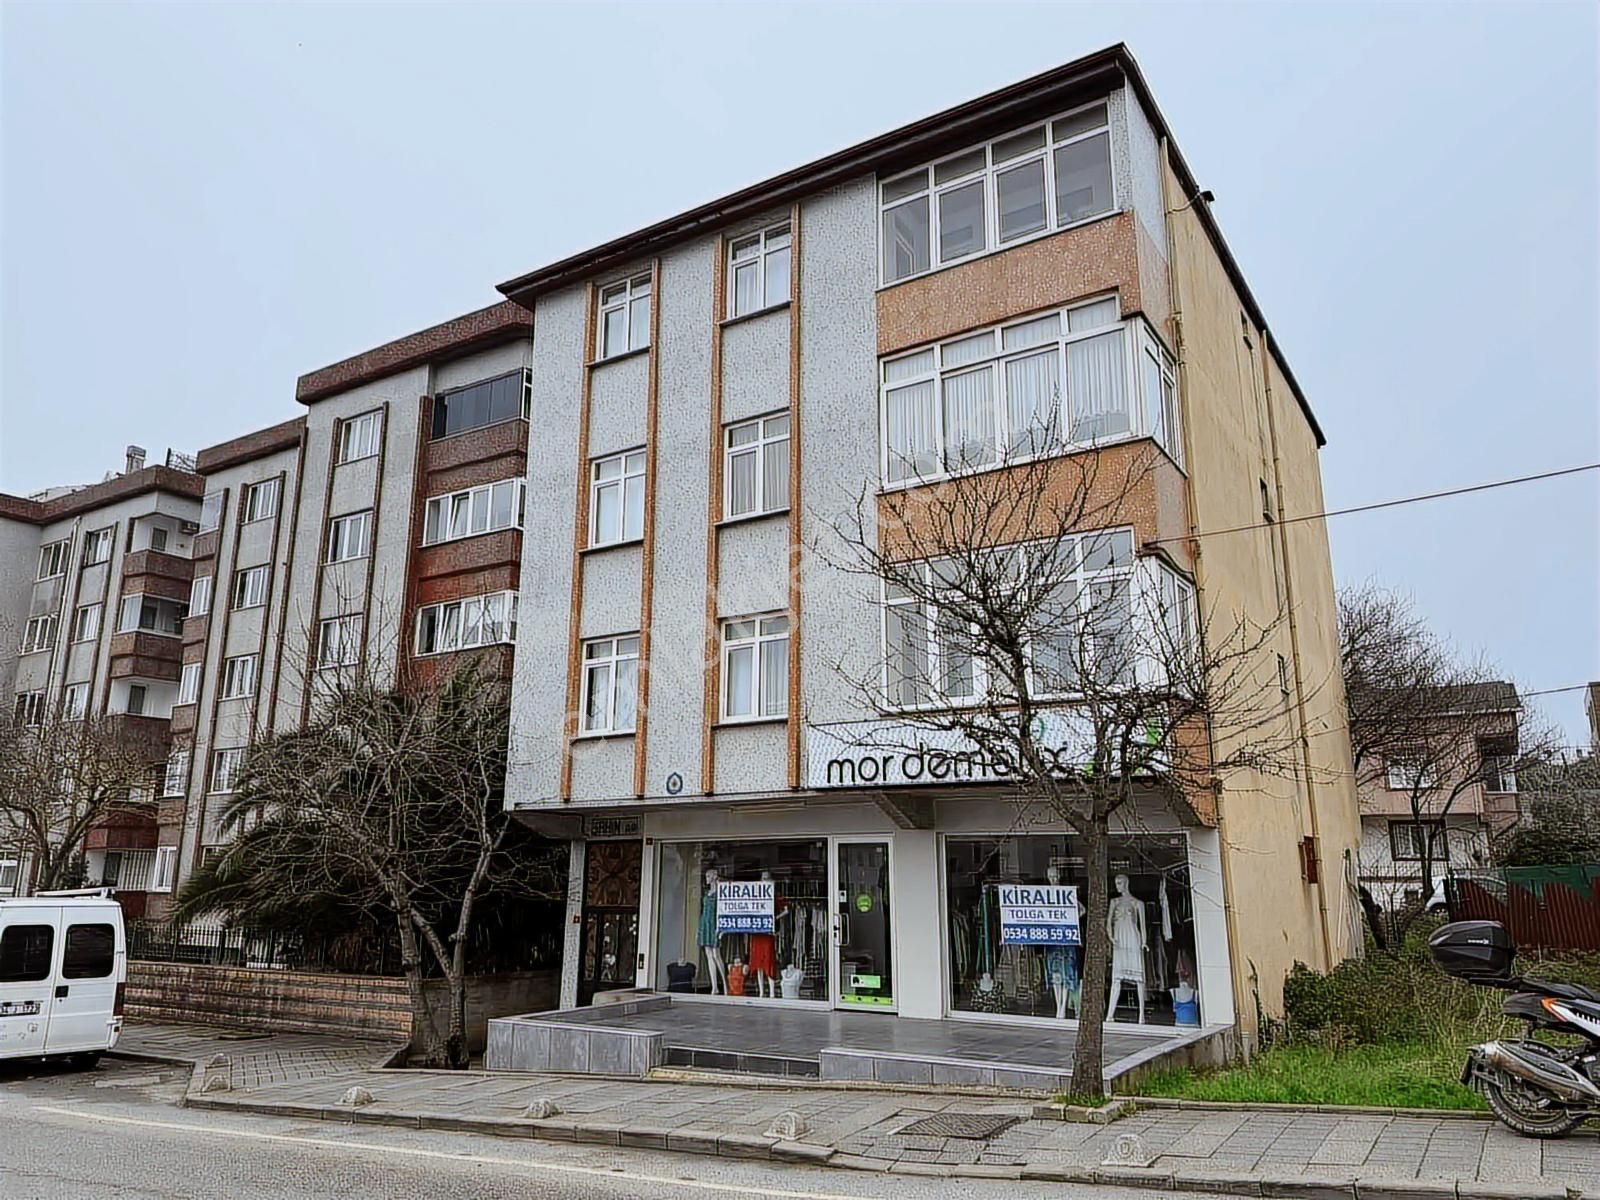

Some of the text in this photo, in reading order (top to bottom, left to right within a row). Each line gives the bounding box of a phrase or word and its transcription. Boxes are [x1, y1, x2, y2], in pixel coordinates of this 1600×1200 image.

[1002, 886, 1074, 905] KİRALIK
[1010, 909, 1067, 919] TOLGA TEK
[1003, 927, 1079, 940] 0534 888 59 92
